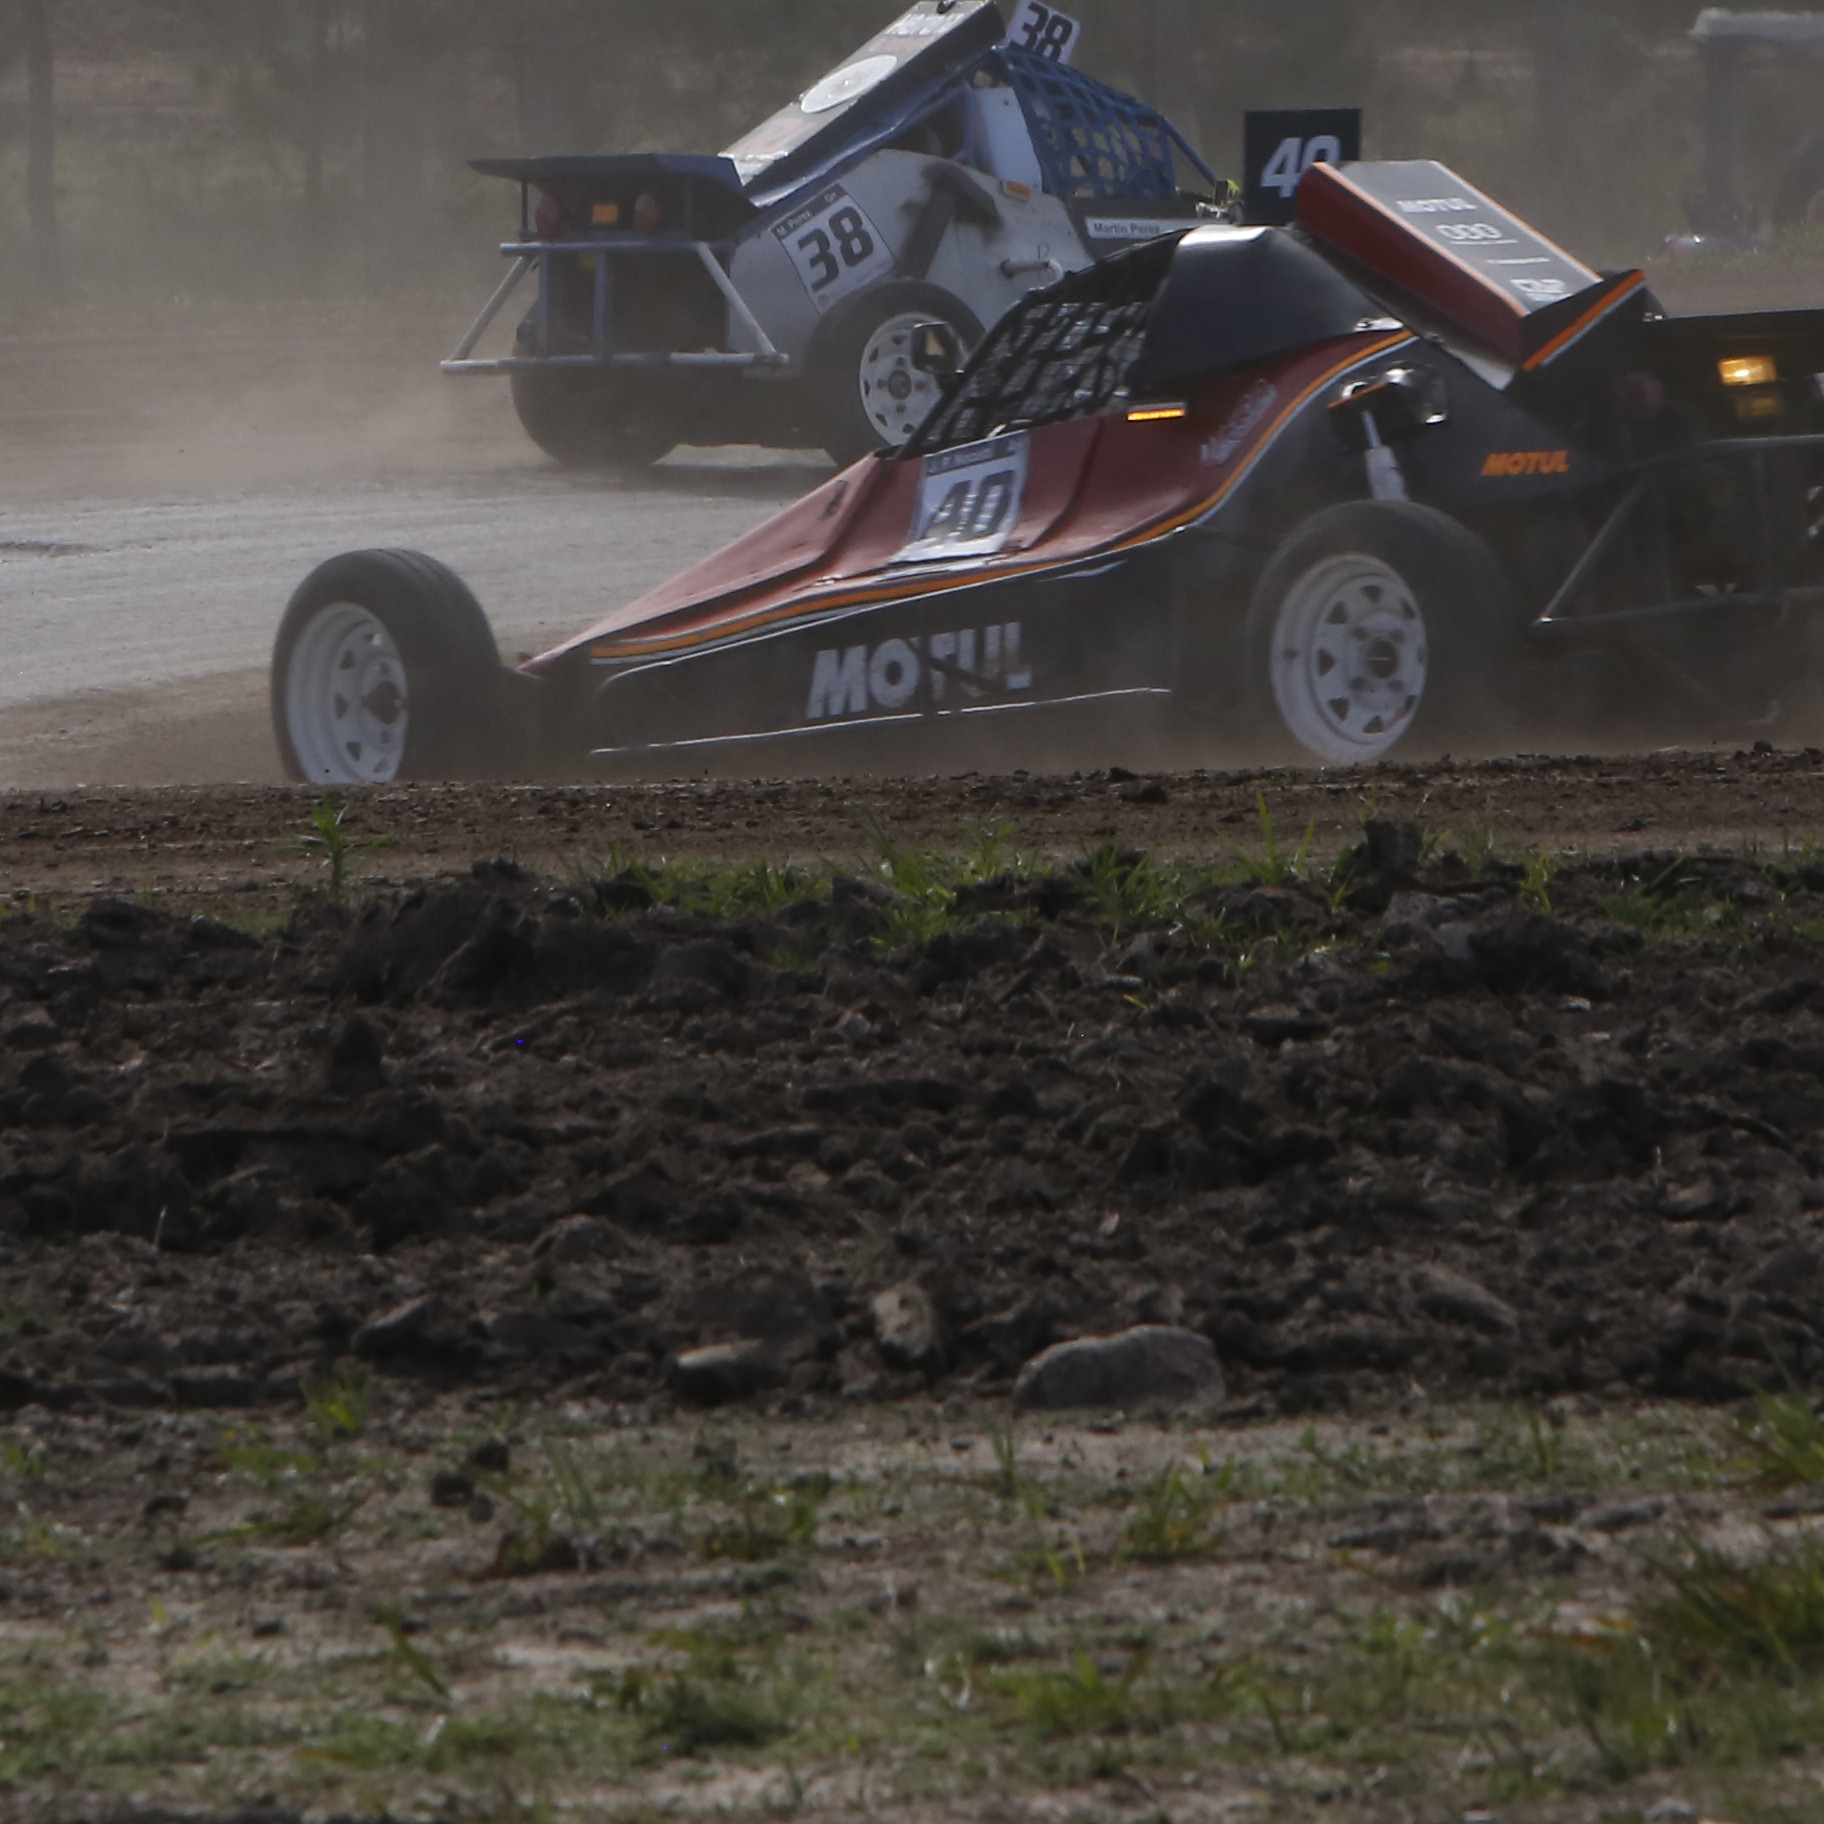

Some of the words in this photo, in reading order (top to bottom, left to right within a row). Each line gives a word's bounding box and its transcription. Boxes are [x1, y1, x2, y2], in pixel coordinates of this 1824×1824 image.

[1016, 1, 1073, 63] 38
[797, 205, 874, 294] 38
[1480, 449, 1571, 477] MOTUL
[922, 469, 1015, 542] 40
[806, 621, 1033, 720] MOTUL
